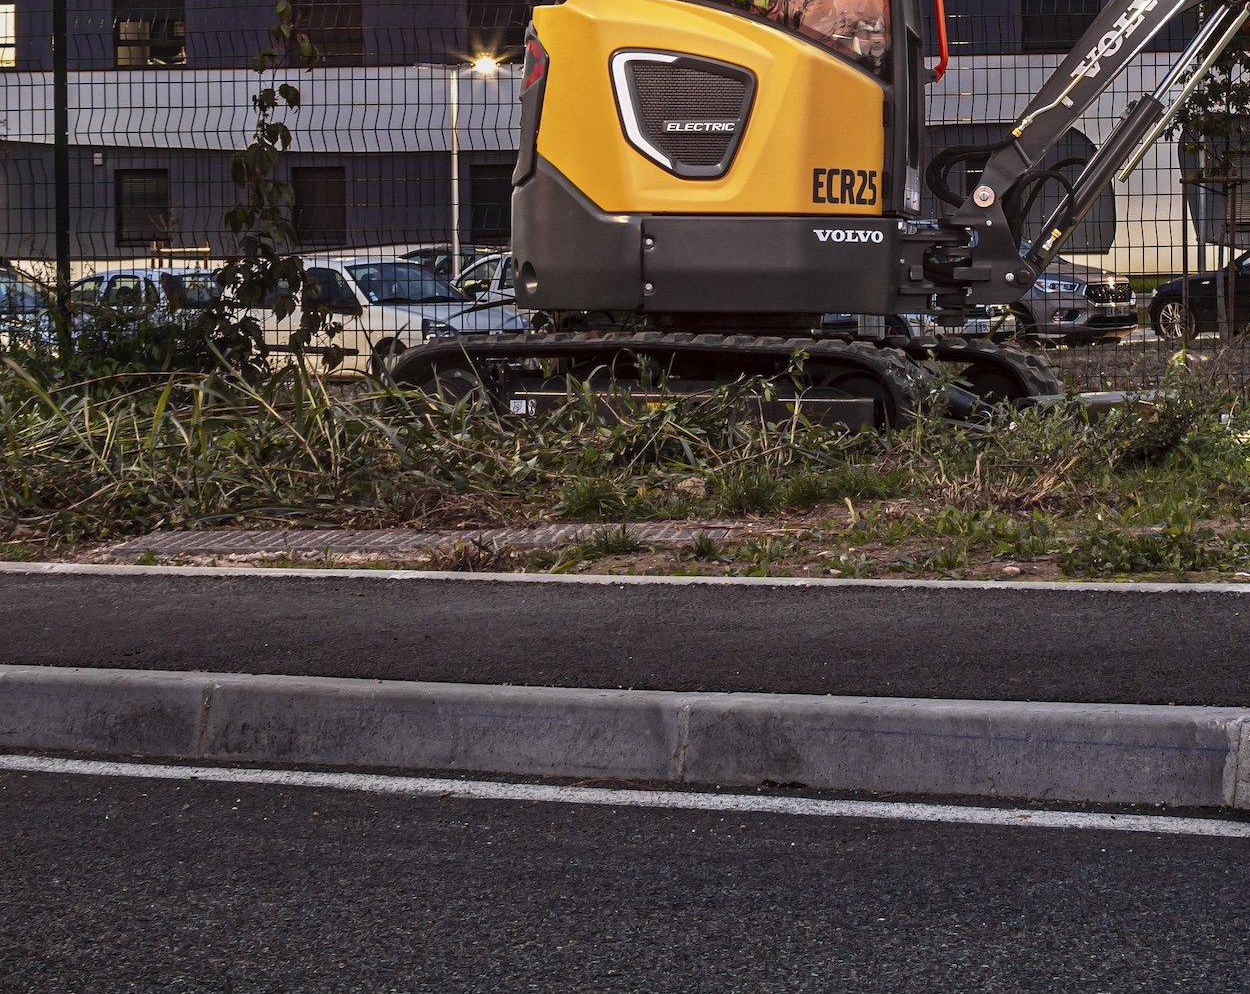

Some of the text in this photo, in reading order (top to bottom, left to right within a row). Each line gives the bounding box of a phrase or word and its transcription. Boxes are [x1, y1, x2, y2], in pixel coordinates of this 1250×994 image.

[666, 122, 736, 132] ELECTRIC
[812, 167, 877, 206] ECR25
[813, 229, 884, 244] VOLVO
